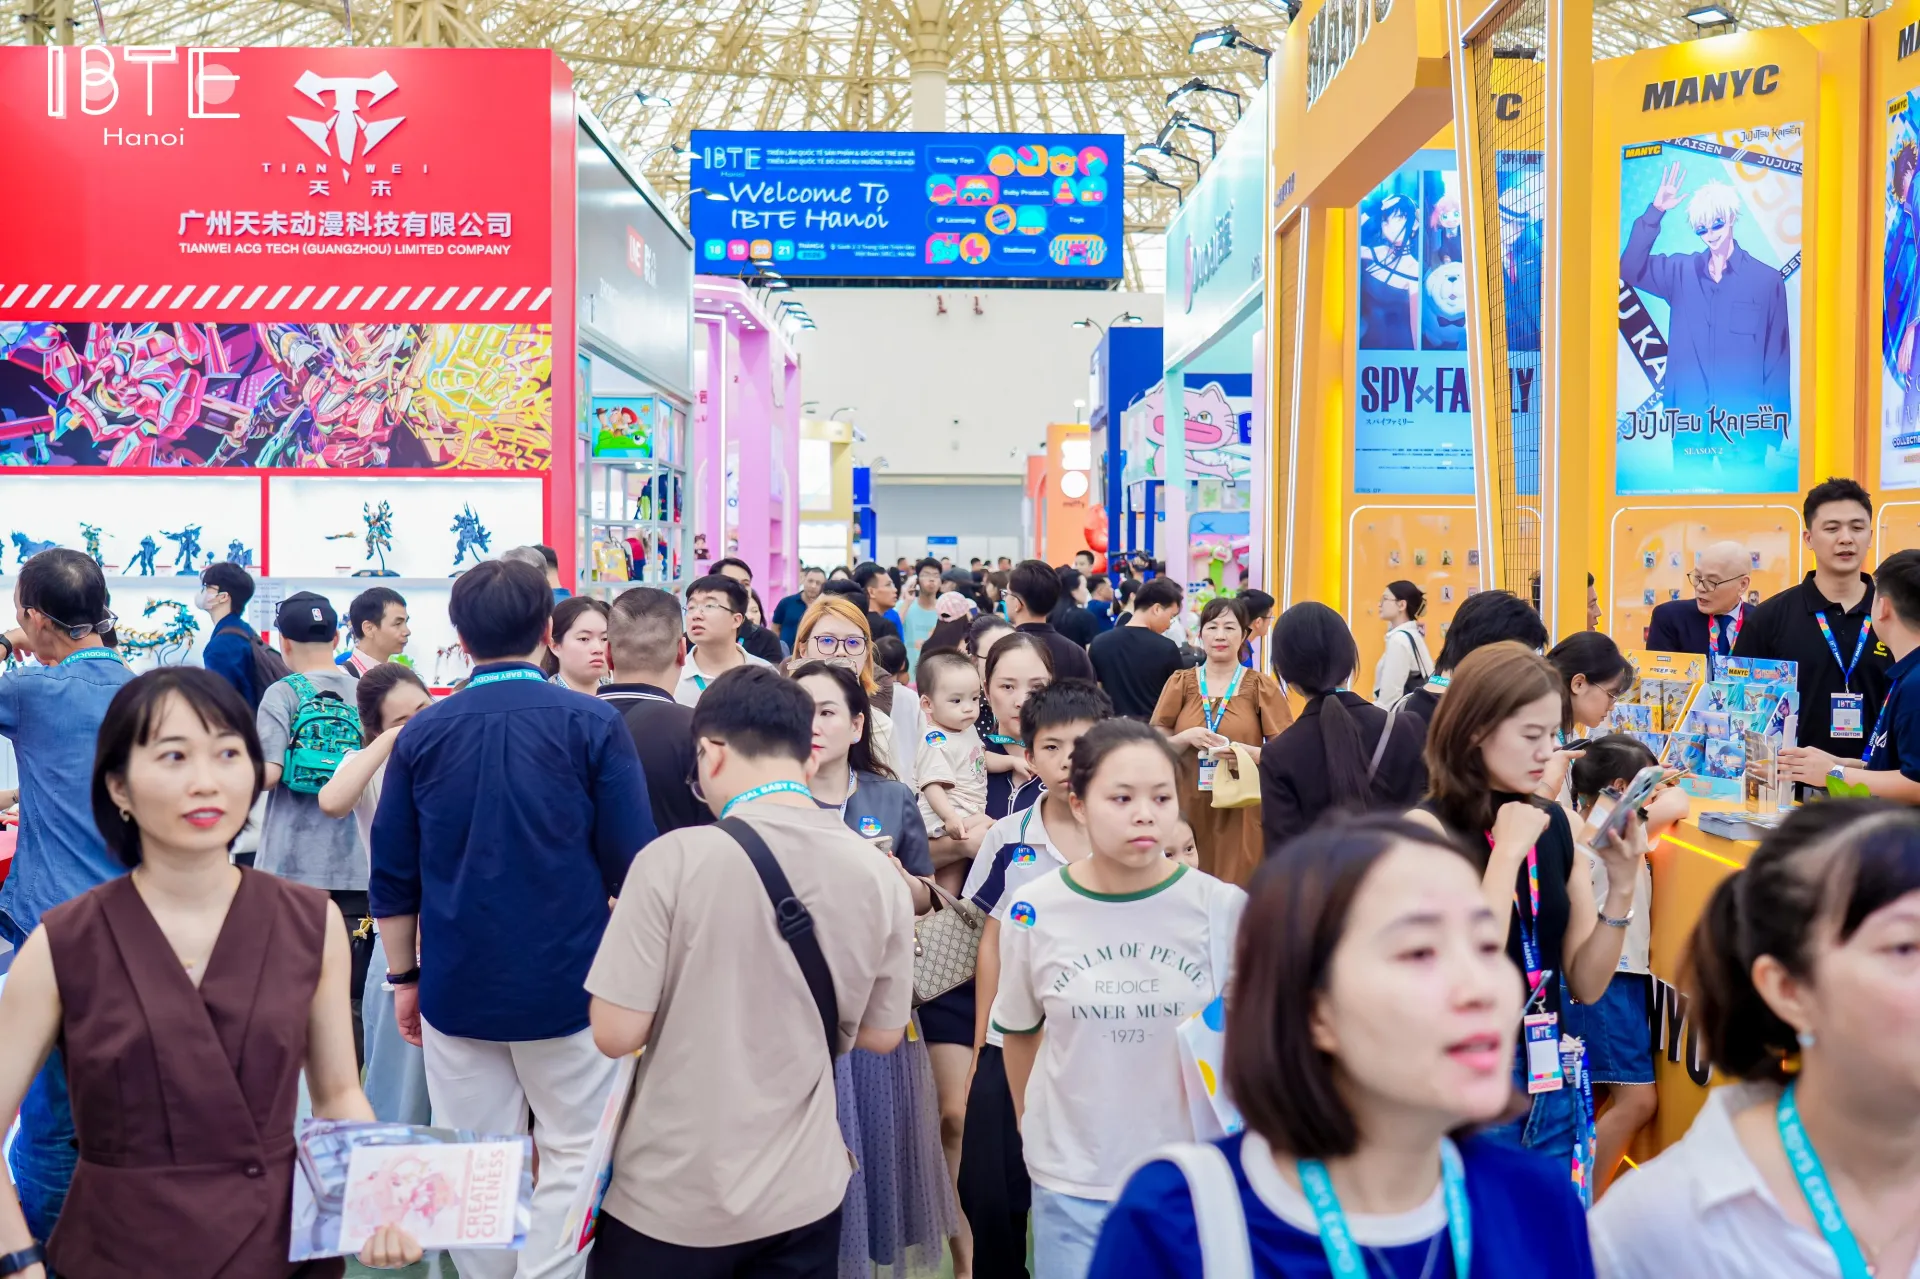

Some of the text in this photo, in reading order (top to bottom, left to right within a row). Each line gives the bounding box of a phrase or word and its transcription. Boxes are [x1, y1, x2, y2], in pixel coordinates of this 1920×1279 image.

[1897, 18, 1920, 61] M
[1642, 64, 1779, 112] MANYC
[1625, 146, 1661, 158] MANYC
[1675, 138, 1722, 155] KAISEN
[704, 147, 761, 169] IBTE
[936, 157, 975, 165] Trendy Toys
[262, 163, 428, 174] TIAN WEI
[729, 181, 889, 204] Welcome To
[1003, 189, 1050, 197] Baby Products
[178, 210, 512, 238] 广州天未动漫科技有限公司
[731, 206, 888, 231] IBTE Hanoi
[937, 216, 976, 225] IP Licensing
[179, 243, 511, 256] TIANWEI ACG TECH (GUANGZHOU) LIMITED COMPANY
[731, 244, 745, 255] 19
[778, 244, 791, 255] 21
[1003, 247, 1036, 255] Stationery
[501, 671, 522, 679] BABY
[1837, 699, 1856, 708] IBTE
[1523, 941, 1535, 969] HANOI
[1054, 941, 1207, 994] REALM OF PEACE
[1094, 978, 1160, 995] REJOICE
[1071, 1002, 1186, 1020] INNER MUSE
[1584, 1069, 1592, 1098] HANOI
[480, 1149, 505, 1238] CUTENESS
[466, 1174, 486, 1239] CREATE
